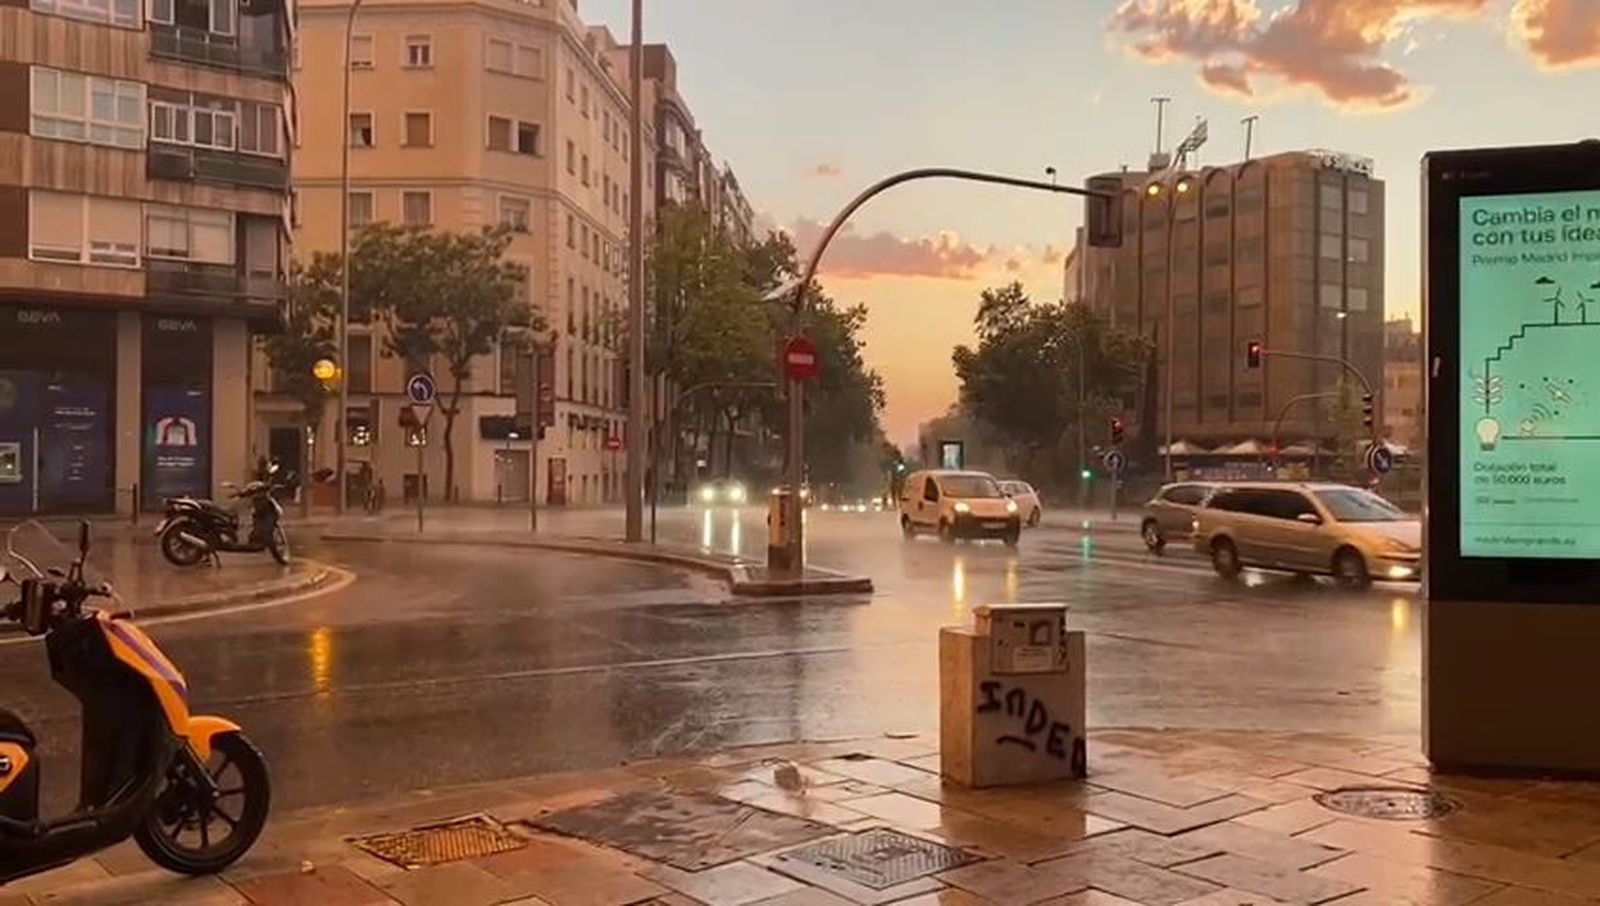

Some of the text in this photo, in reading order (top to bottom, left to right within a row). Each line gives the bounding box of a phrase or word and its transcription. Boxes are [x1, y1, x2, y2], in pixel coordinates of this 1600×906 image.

[1472, 206, 1555, 226] Cambia
[1562, 204, 1580, 222] el
[1472, 231, 1514, 245] con
[1521, 229, 1555, 244] tus
[17, 310, 61, 323] BBVA
[158, 318, 197, 331] BBVA
